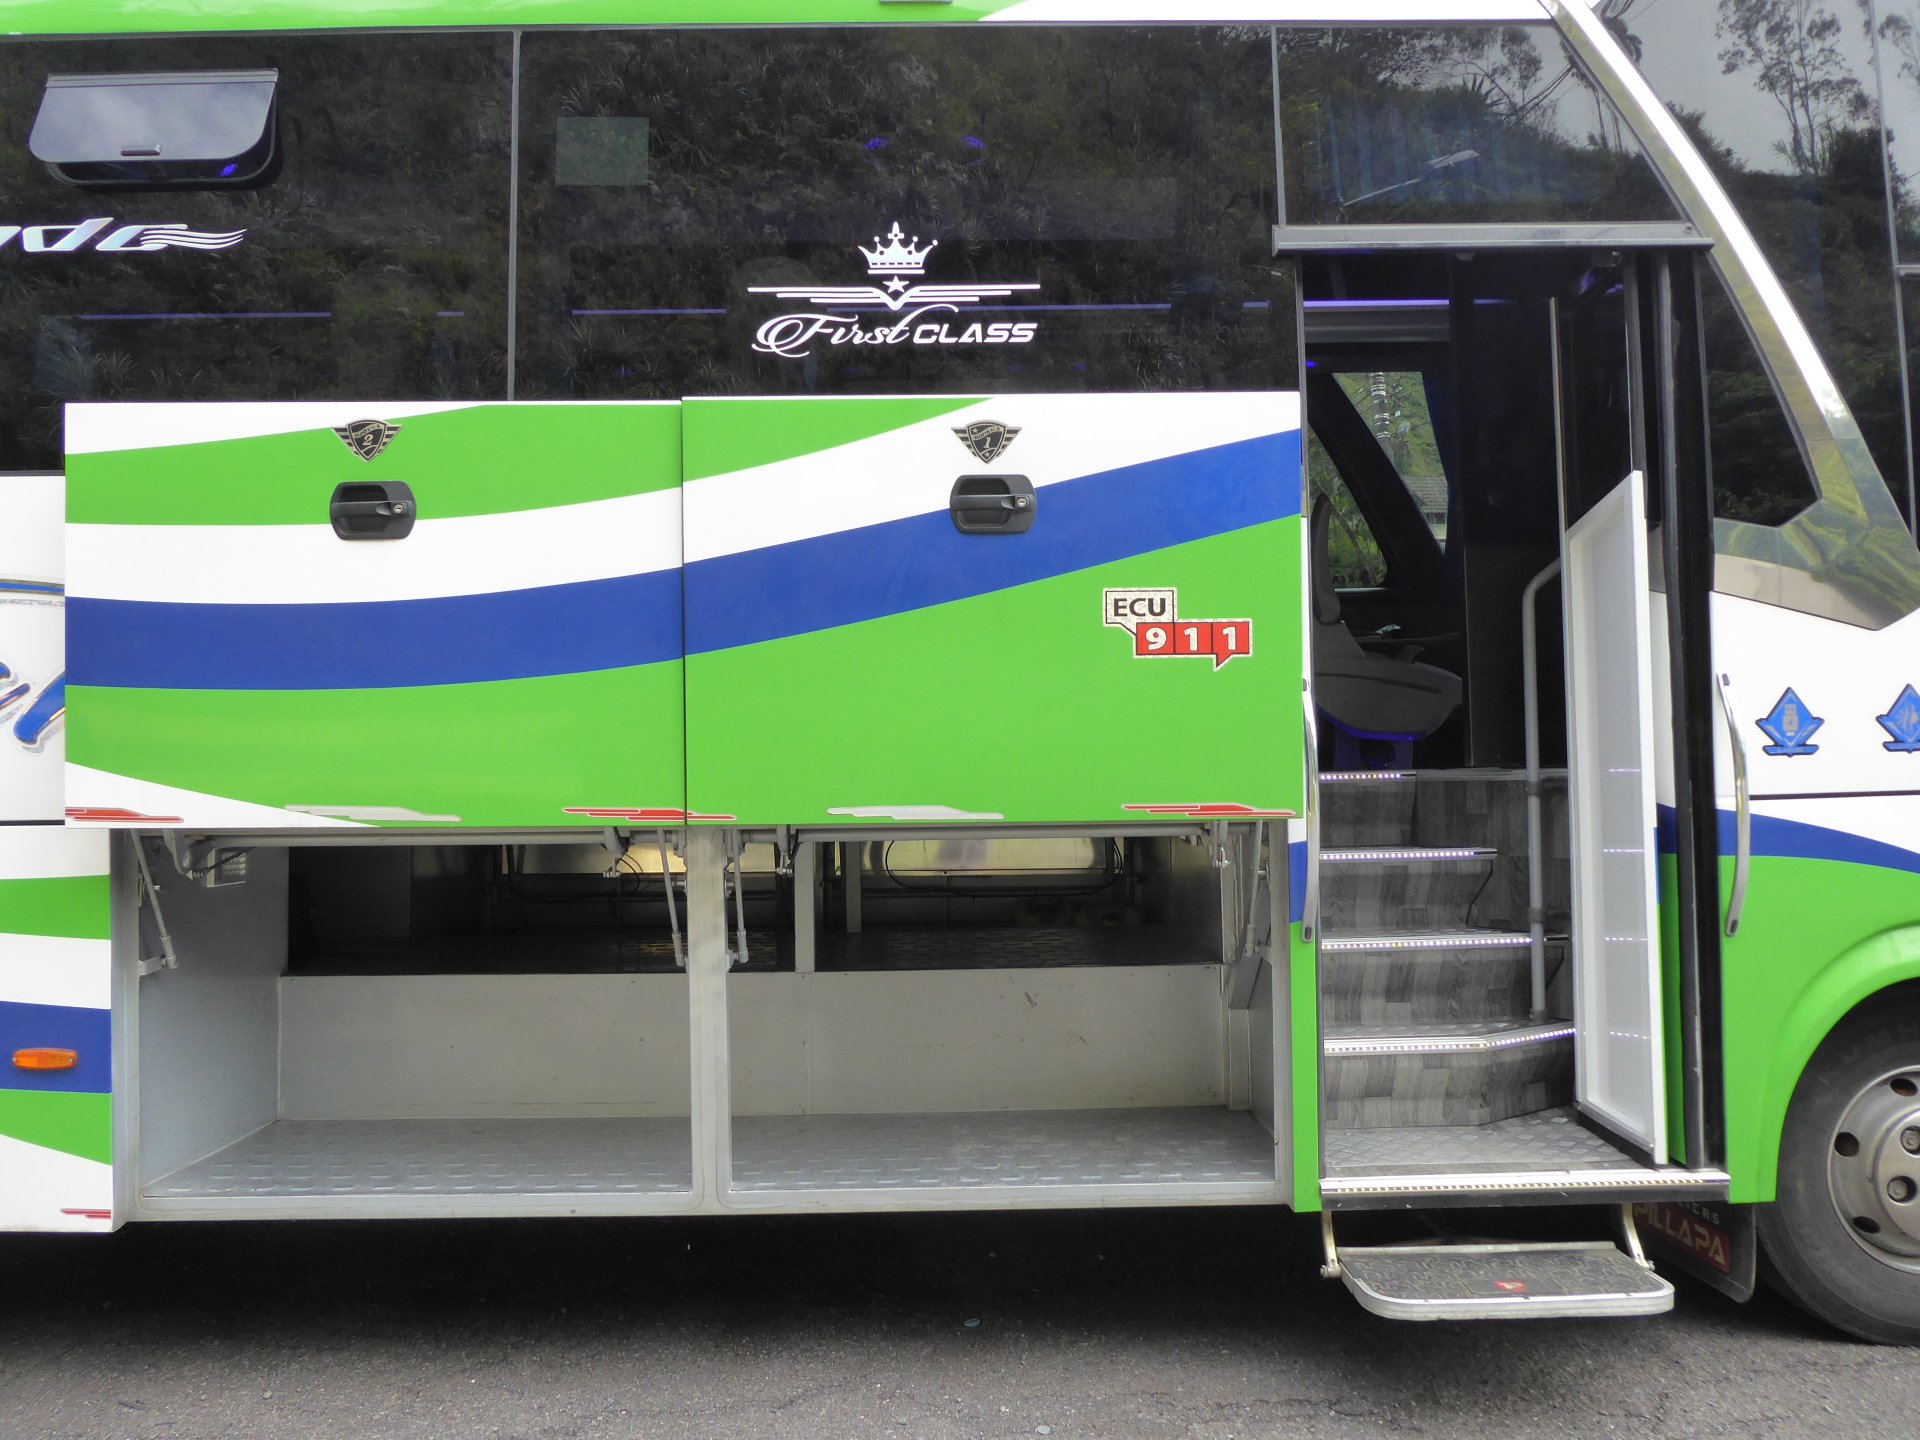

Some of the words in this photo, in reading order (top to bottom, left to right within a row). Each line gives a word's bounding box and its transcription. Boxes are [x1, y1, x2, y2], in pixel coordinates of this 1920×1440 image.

[751, 303, 959, 358] First
[912, 322, 1038, 344] CLASS
[362, 433, 374, 446] 2
[982, 436, 992, 449] 1
[1113, 597, 1166, 617] ECU
